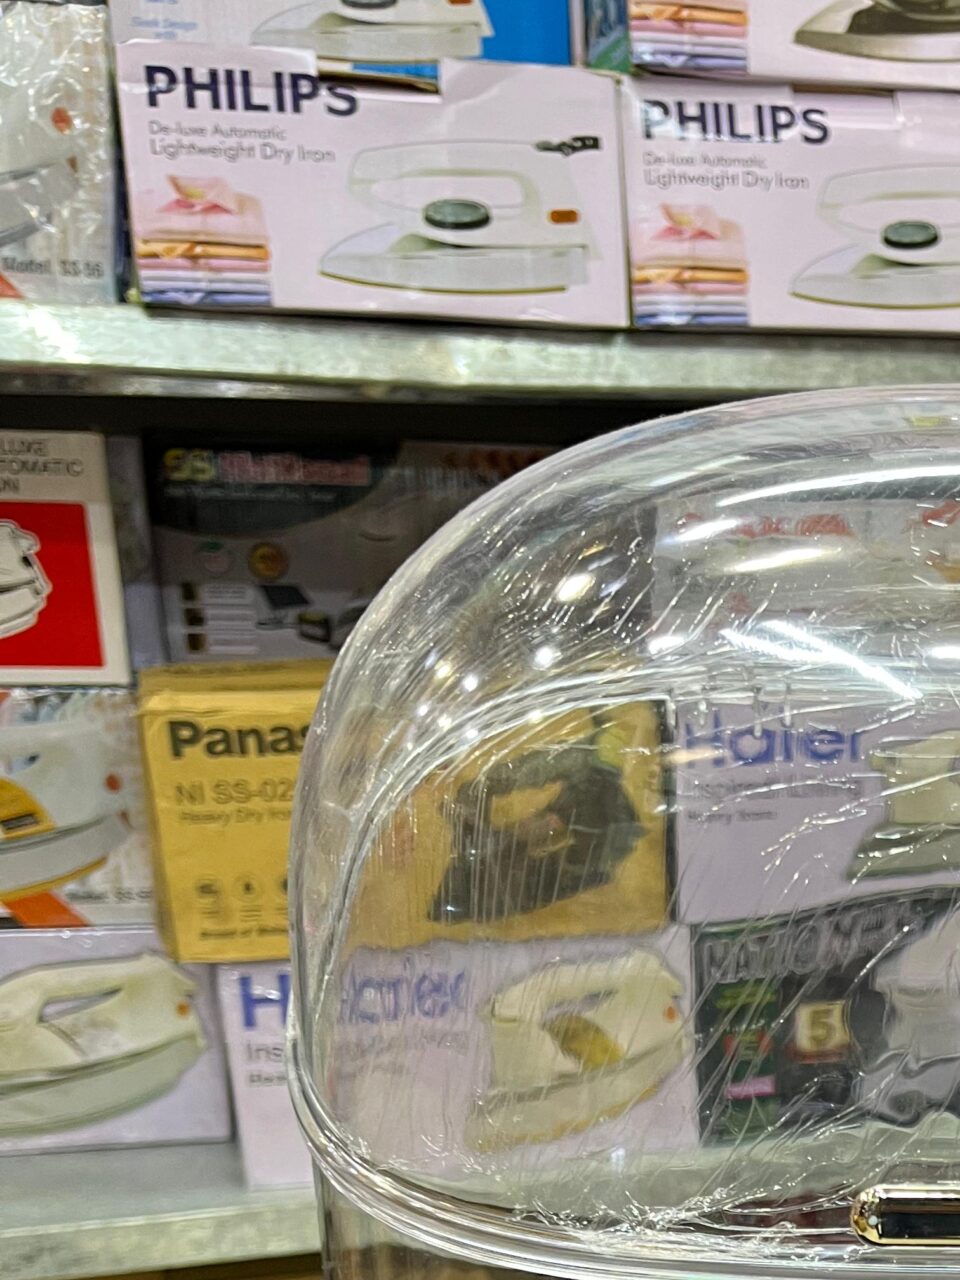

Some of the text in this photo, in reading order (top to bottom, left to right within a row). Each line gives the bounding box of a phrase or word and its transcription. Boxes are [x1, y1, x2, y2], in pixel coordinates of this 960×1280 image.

[145, 65, 359, 117] PHILIPS
[212, 125, 287, 141] Automatic
[643, 99, 829, 145] PHILIPS
[150, 138, 337, 165] Lightweight Dry Iron
[644, 168, 811, 193] Lightweight Dry Iron
